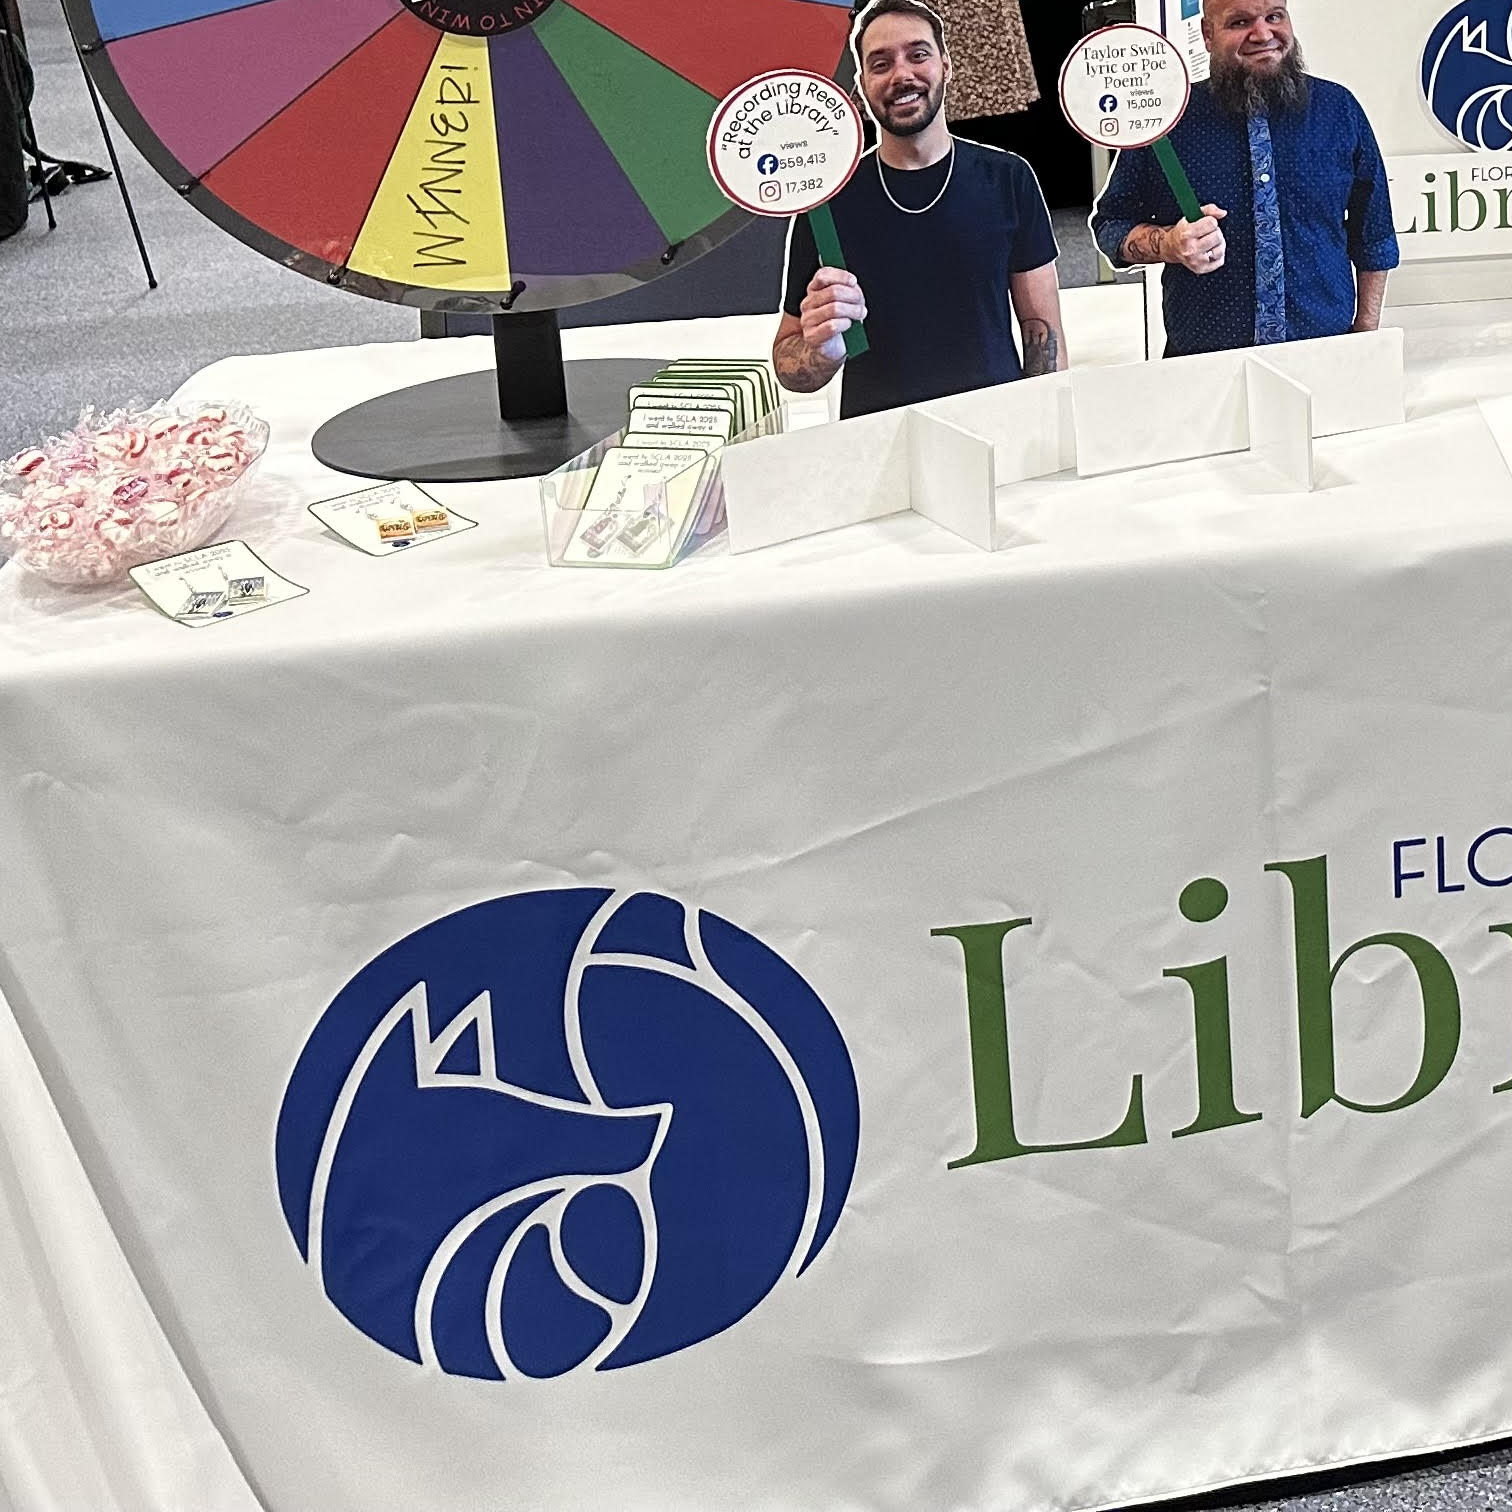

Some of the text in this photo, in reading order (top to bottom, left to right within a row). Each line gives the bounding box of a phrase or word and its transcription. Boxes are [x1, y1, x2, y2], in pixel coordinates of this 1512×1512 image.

[420, 0, 470, 30] WIN
[480, 16, 512, 30] TO
[1082, 41, 1168, 61] Taylor Swift
[1085, 59, 1167, 78] lyric or Poe
[1103, 72, 1151, 89] Poem?
[806, 82, 846, 120] Reels
[1126, 97, 1162, 110] 15,000
[744, 110, 772, 136] the
[1128, 117, 1163, 130] 79,777
[738, 140, 752, 160] at
[406, 65, 480, 268] WINNER!
[779, 152, 826, 170] 559,413
[785, 178, 823, 194] 17,382
